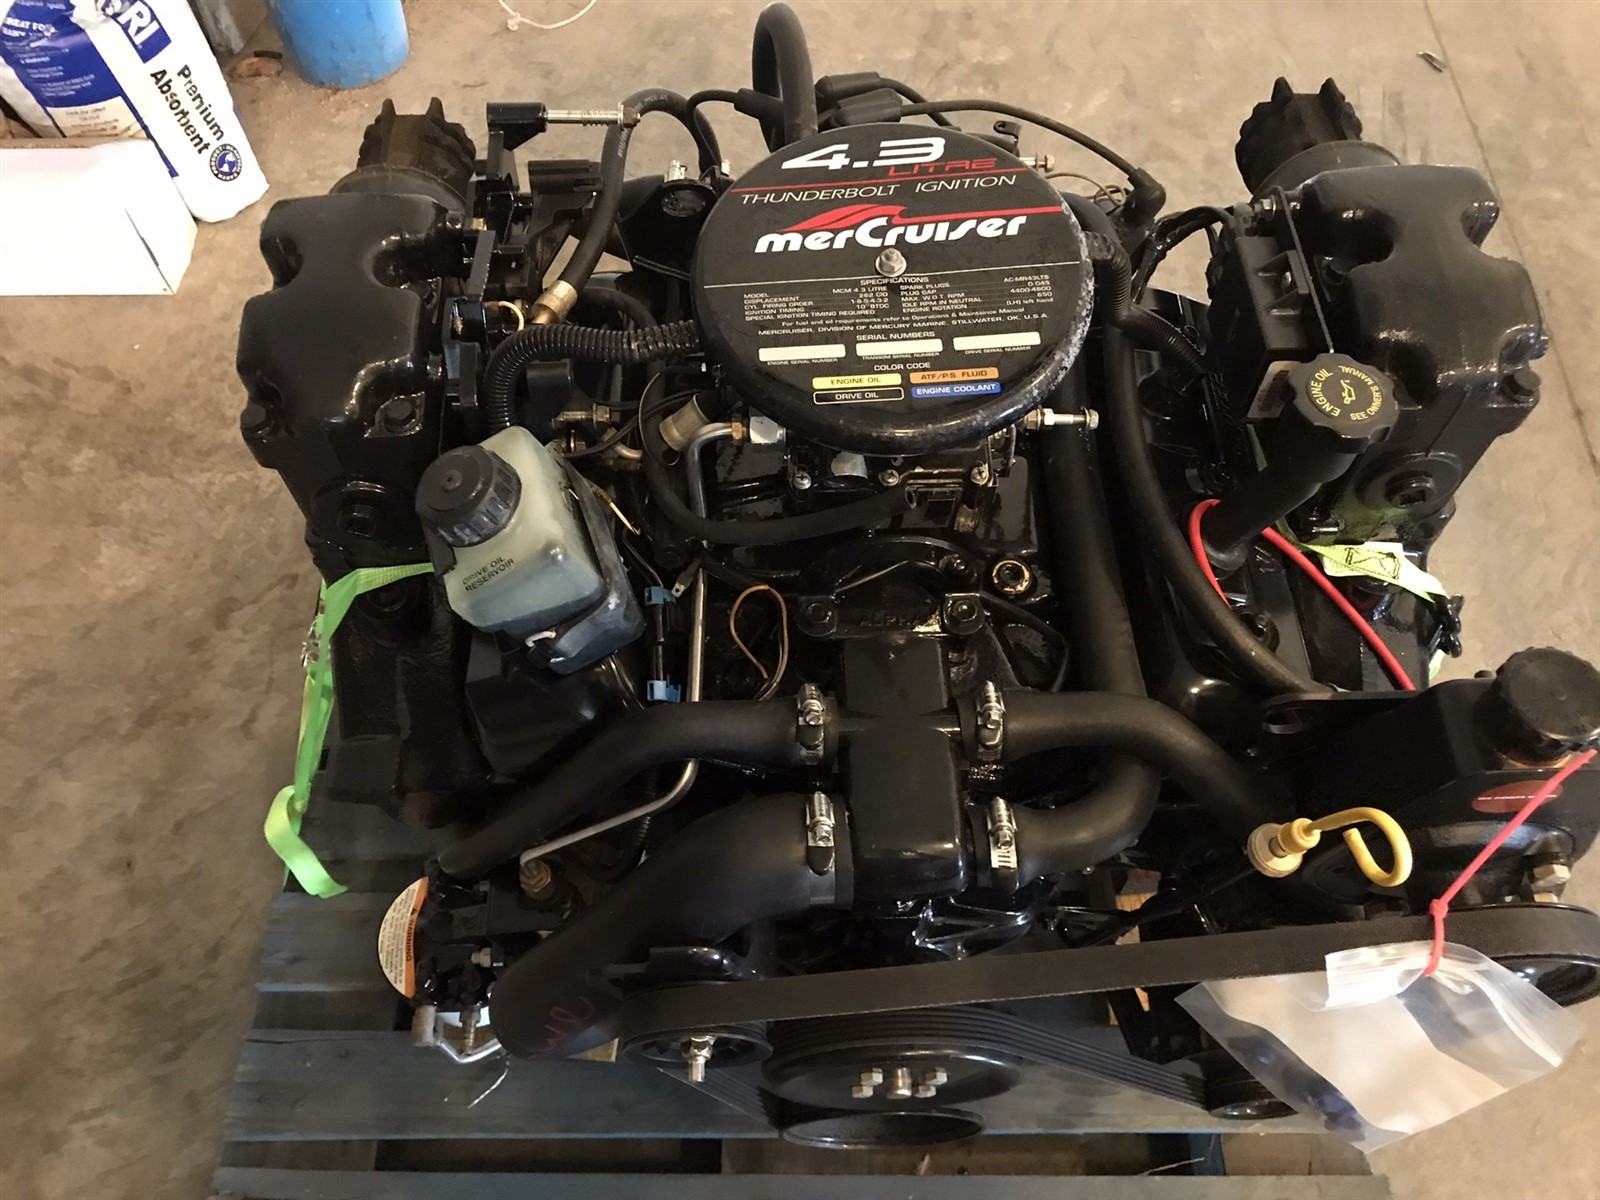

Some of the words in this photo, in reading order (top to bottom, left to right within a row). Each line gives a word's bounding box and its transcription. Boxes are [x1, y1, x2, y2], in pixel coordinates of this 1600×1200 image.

[150, 69, 211, 154] Absorbent
[177, 64, 224, 141] Premium
[781, 137, 946, 170] 4.3
[888, 158, 997, 176] LITRE
[742, 184, 900, 204] THUNDERBOLT
[915, 175, 1016, 193] IGNITION
[860, 277, 929, 285] SPECIFICATIONS
[744, 296, 799, 304] DISPLACEMENT
[890, 331, 935, 339] NUMBERS
[1315, 368, 1333, 381] OIL
[1338, 365, 1374, 386] MANUAL
[954, 384, 995, 392] COOLANT
[1311, 380, 1340, 417] ENGINE
[1350, 412, 1368, 420] SEE
[463, 565, 488, 585] DRIVE
[490, 557, 504, 568] OIL
[465, 558, 514, 591] RESERVOIR
